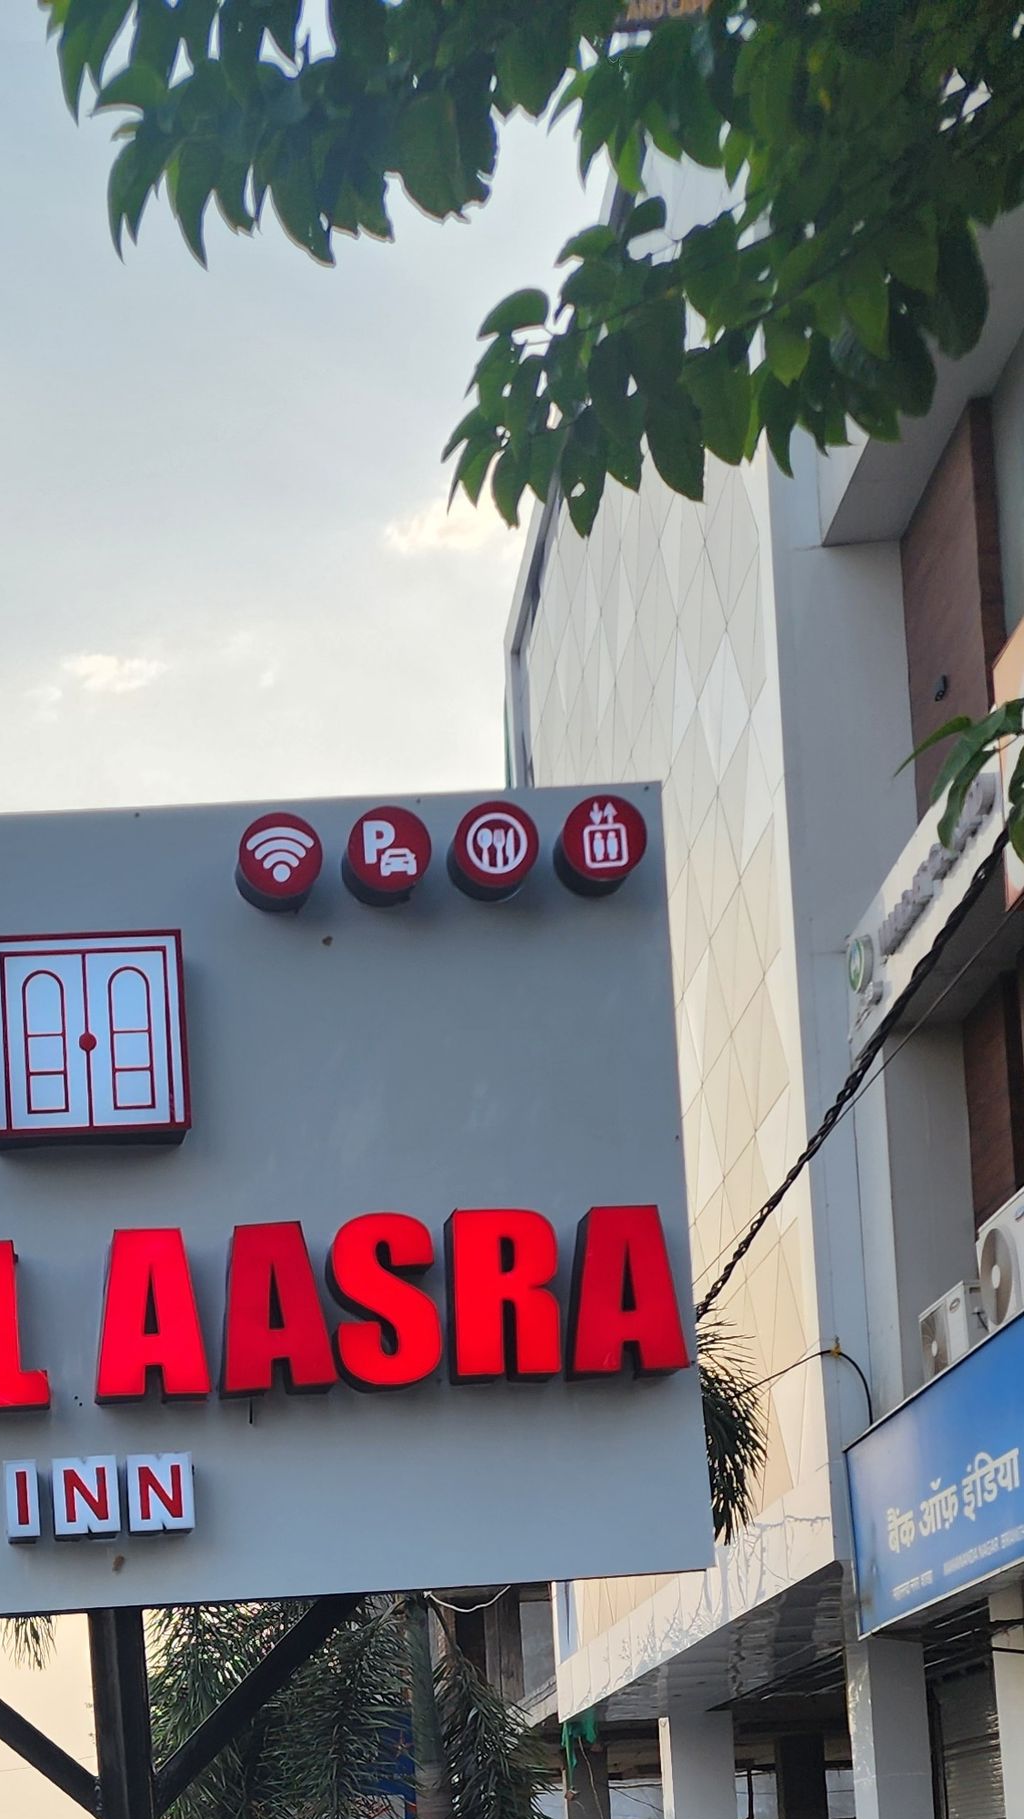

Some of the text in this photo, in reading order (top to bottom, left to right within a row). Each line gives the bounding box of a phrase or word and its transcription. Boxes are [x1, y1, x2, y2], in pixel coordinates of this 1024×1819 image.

[94, 1205, 689, 1398] AASRA
[12, 1460, 188, 1530] INN
[886, 1506, 916, 1554] बैंक
[962, 1447, 1021, 1522] इंडिया
